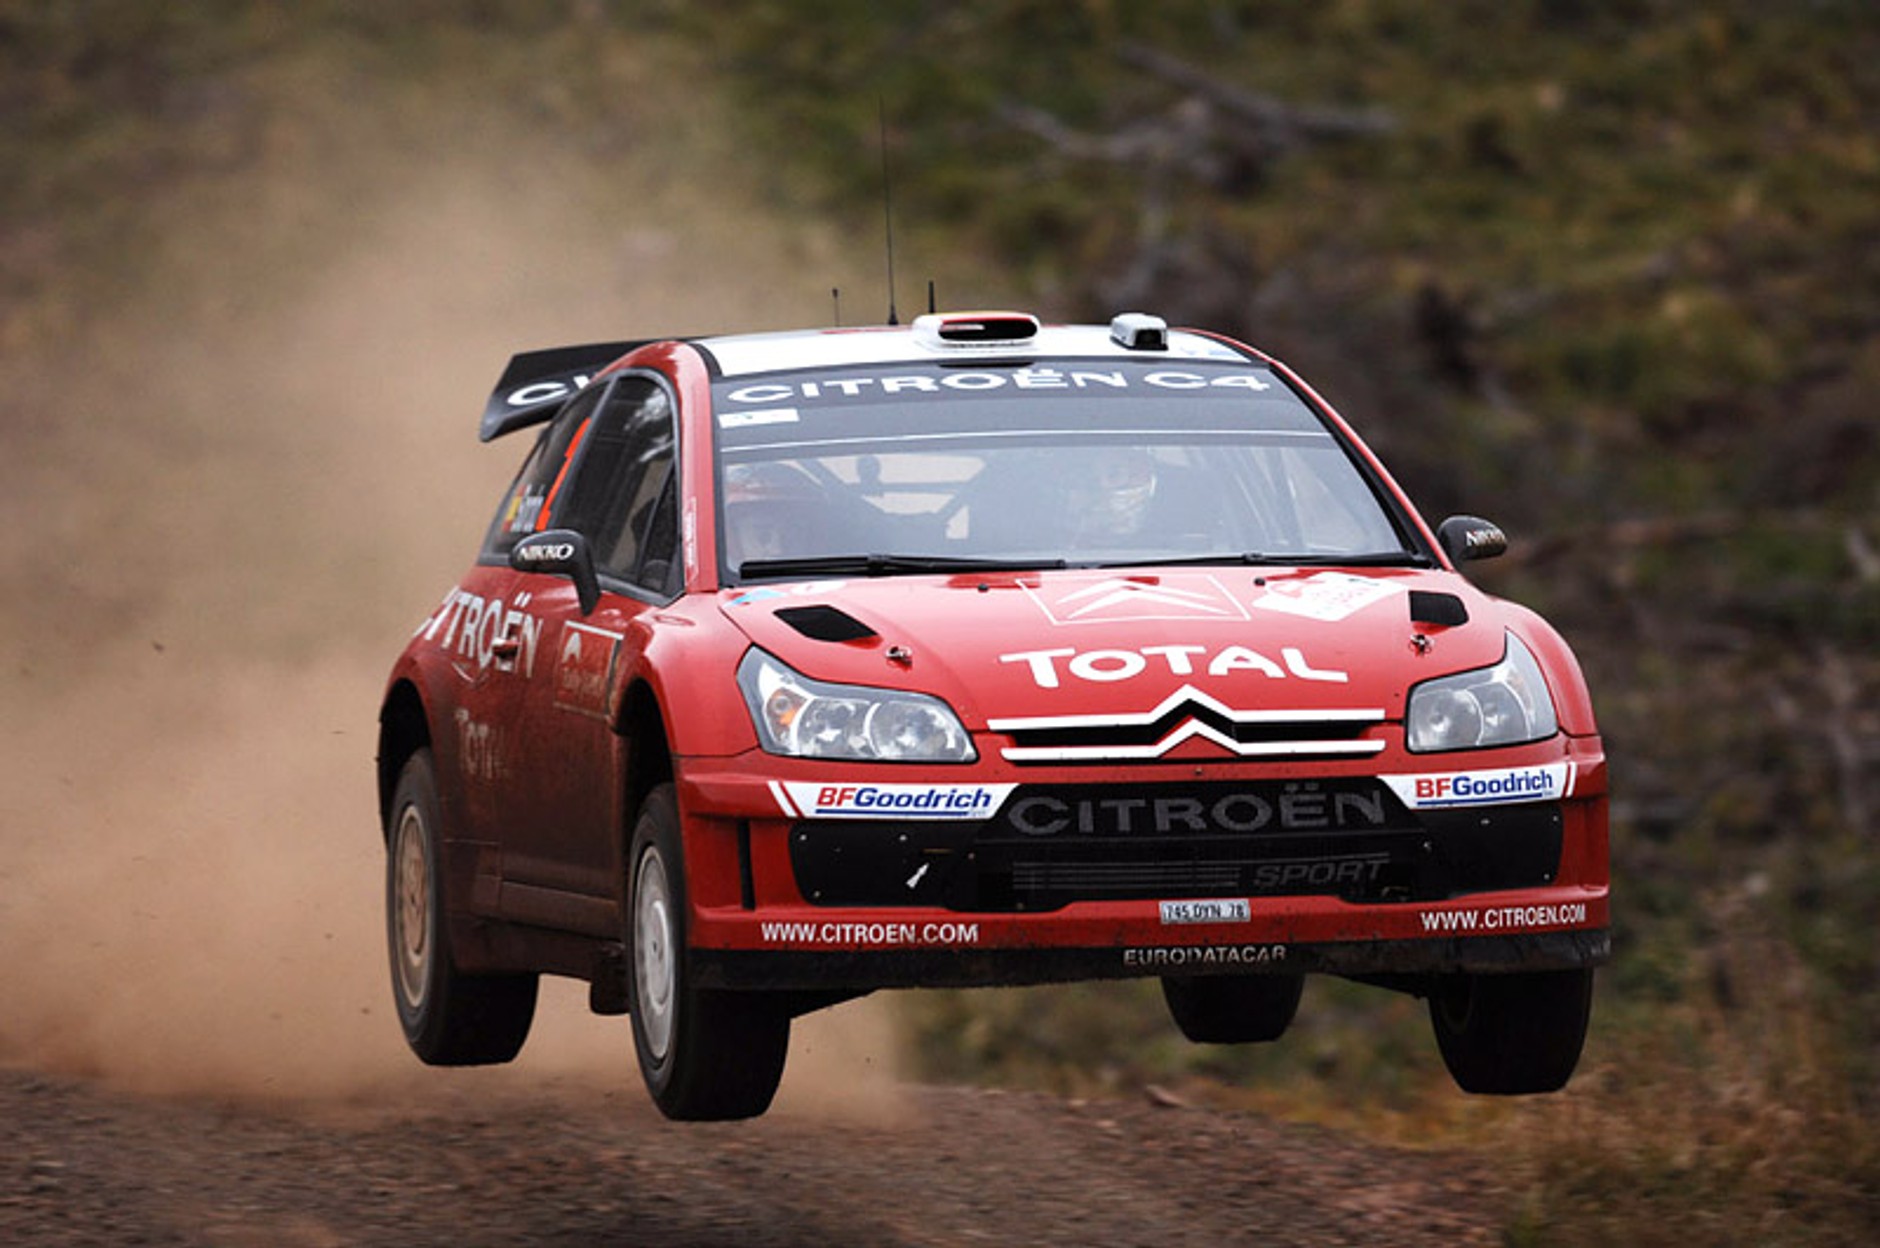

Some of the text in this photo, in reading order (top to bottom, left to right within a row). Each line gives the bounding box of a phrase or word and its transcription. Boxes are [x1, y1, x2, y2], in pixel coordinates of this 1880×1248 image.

[727, 368, 1271, 403] CITROËN C4
[999, 645, 1349, 688] TOTAL
[816, 787, 992, 808] BFGoodrich
[1415, 769, 1553, 798] BFGoodrich
[1008, 782, 1386, 836] CITROËN
[1253, 858, 1390, 888] SPORT
[1420, 902, 1587, 931] WWW.CITROEN.COM
[761, 922, 980, 944] WWW.CITROEN.COM
